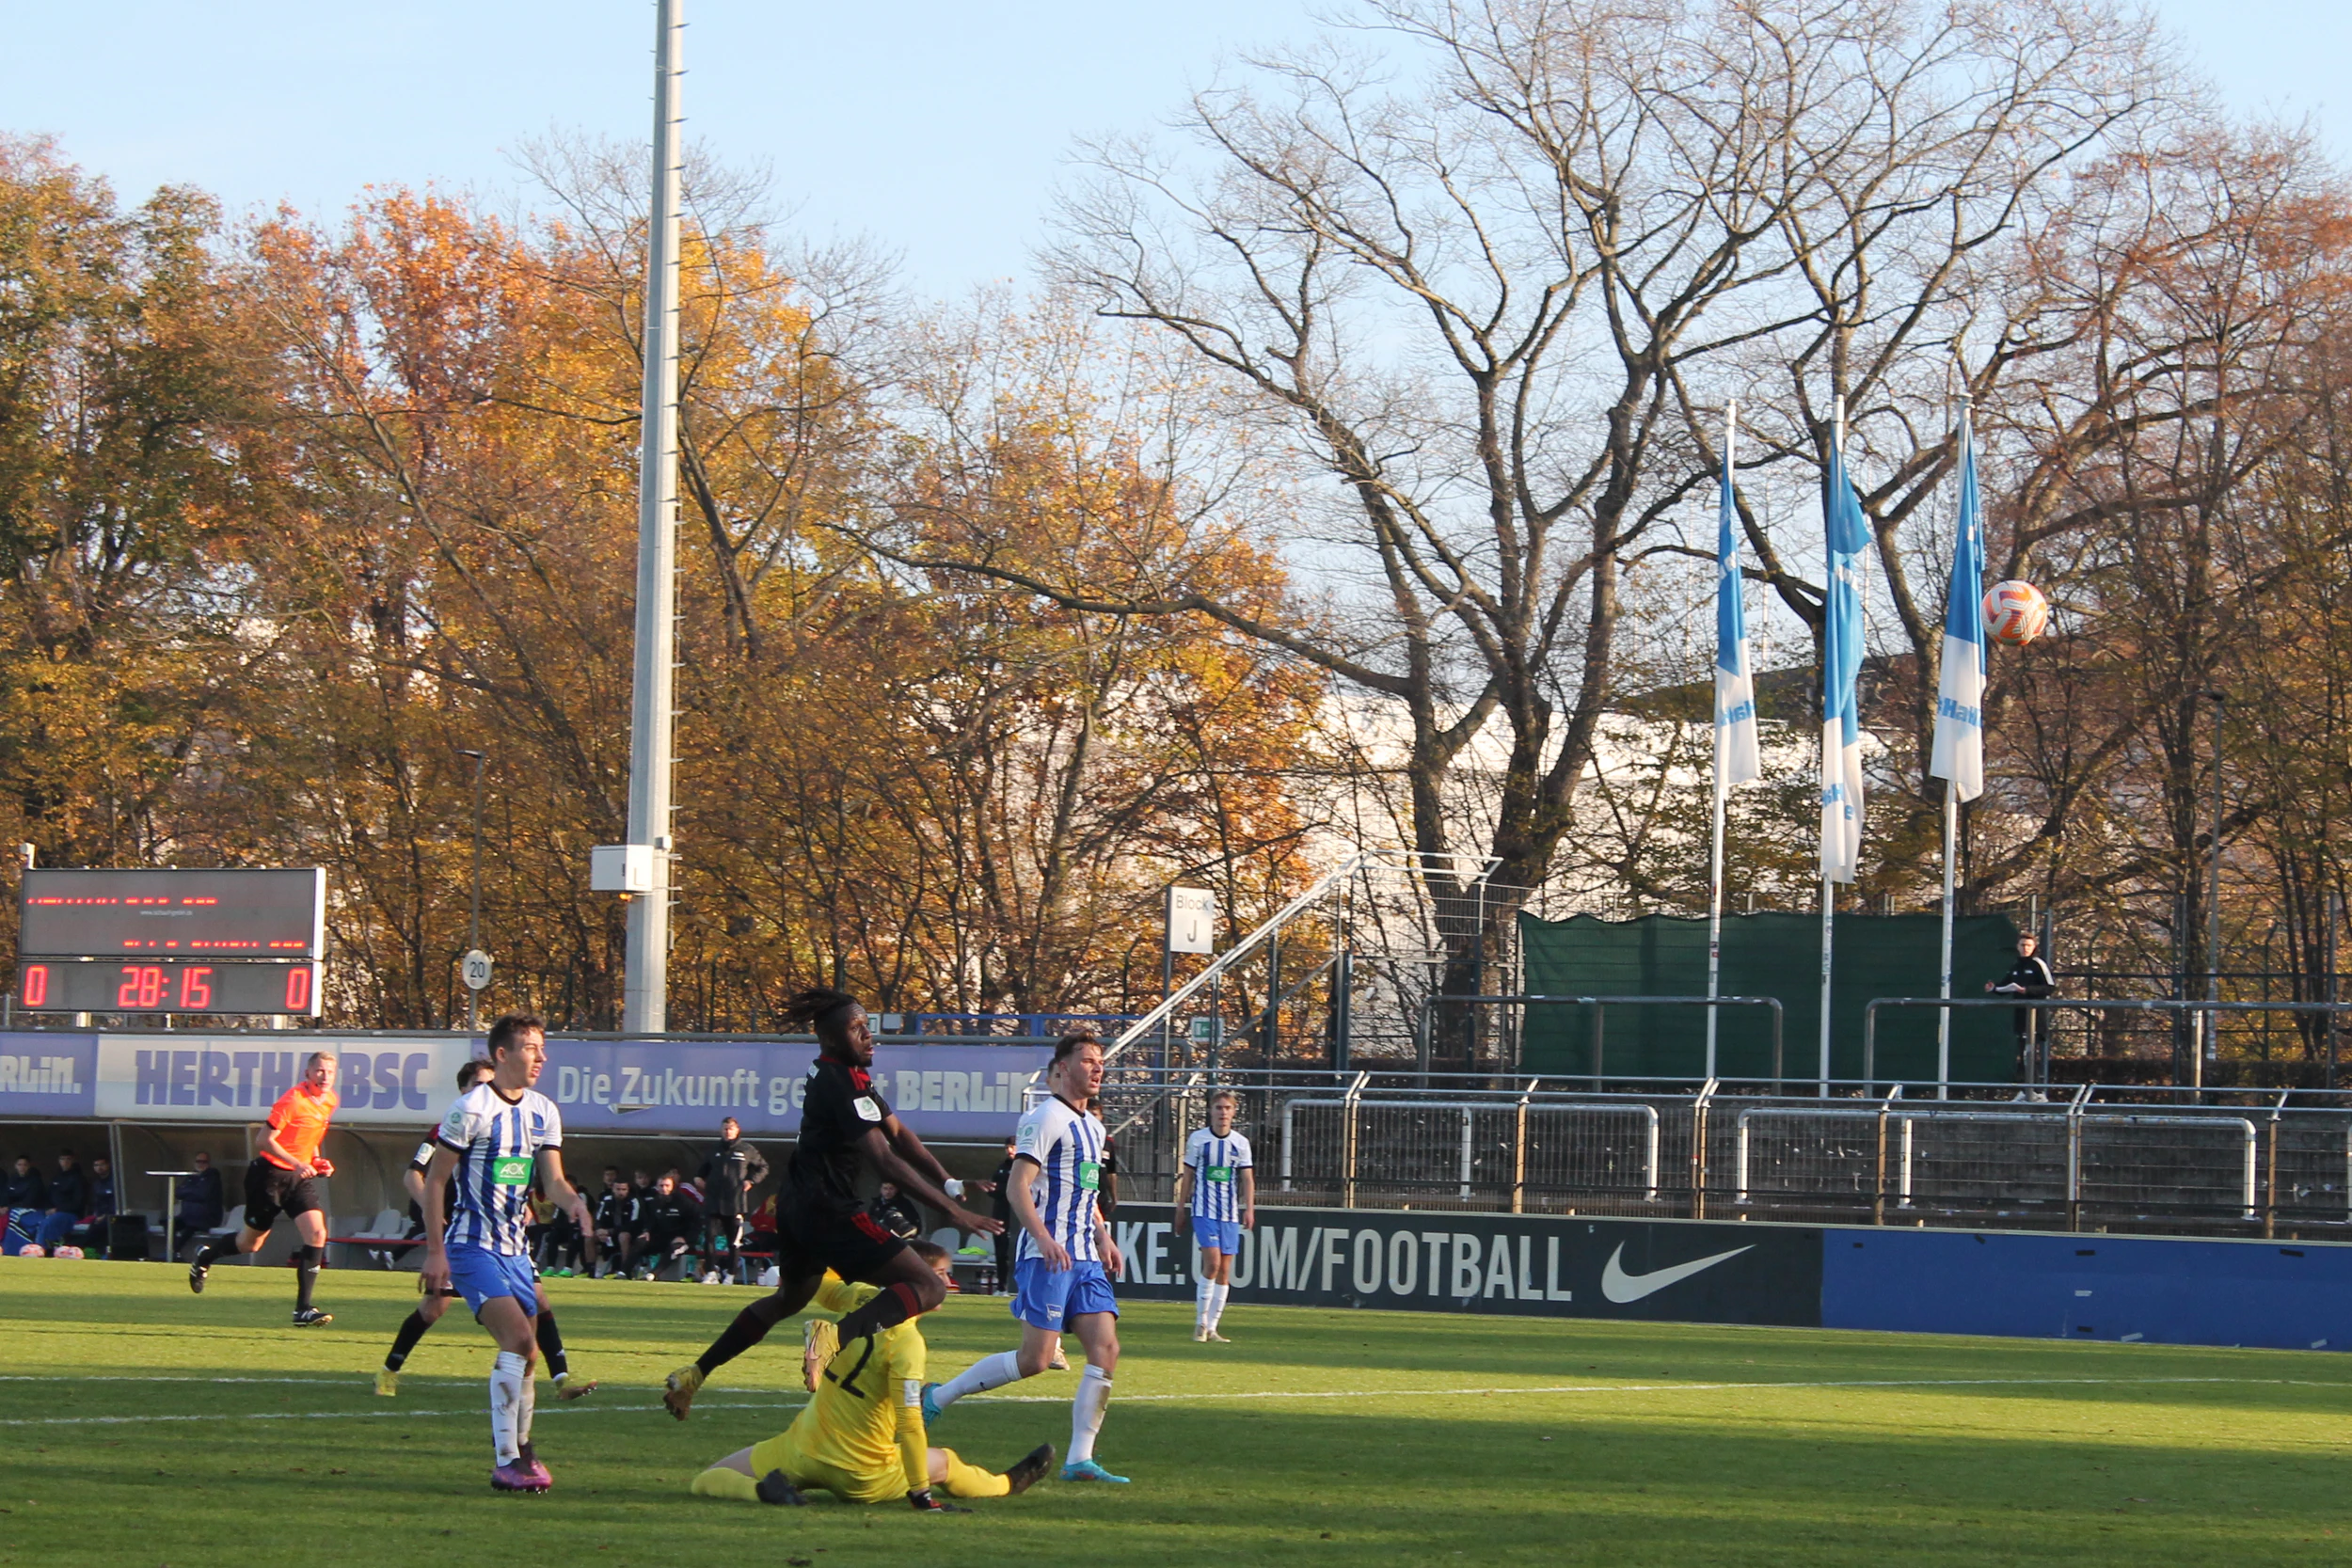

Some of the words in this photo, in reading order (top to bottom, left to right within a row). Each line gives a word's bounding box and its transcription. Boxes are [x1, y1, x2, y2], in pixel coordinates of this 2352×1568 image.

[1176, 895, 1210, 911] Block
[1187, 920, 1198, 942] J
[469, 960, 485, 978] 20
[24, 965, 47, 1006] 0
[286, 968, 310, 1009] 0
[135, 1050, 310, 1108] HERTH
[340, 1053, 429, 1111] BSC
[557, 1066, 612, 1105] Die
[620, 1067, 760, 1108] Zukunft
